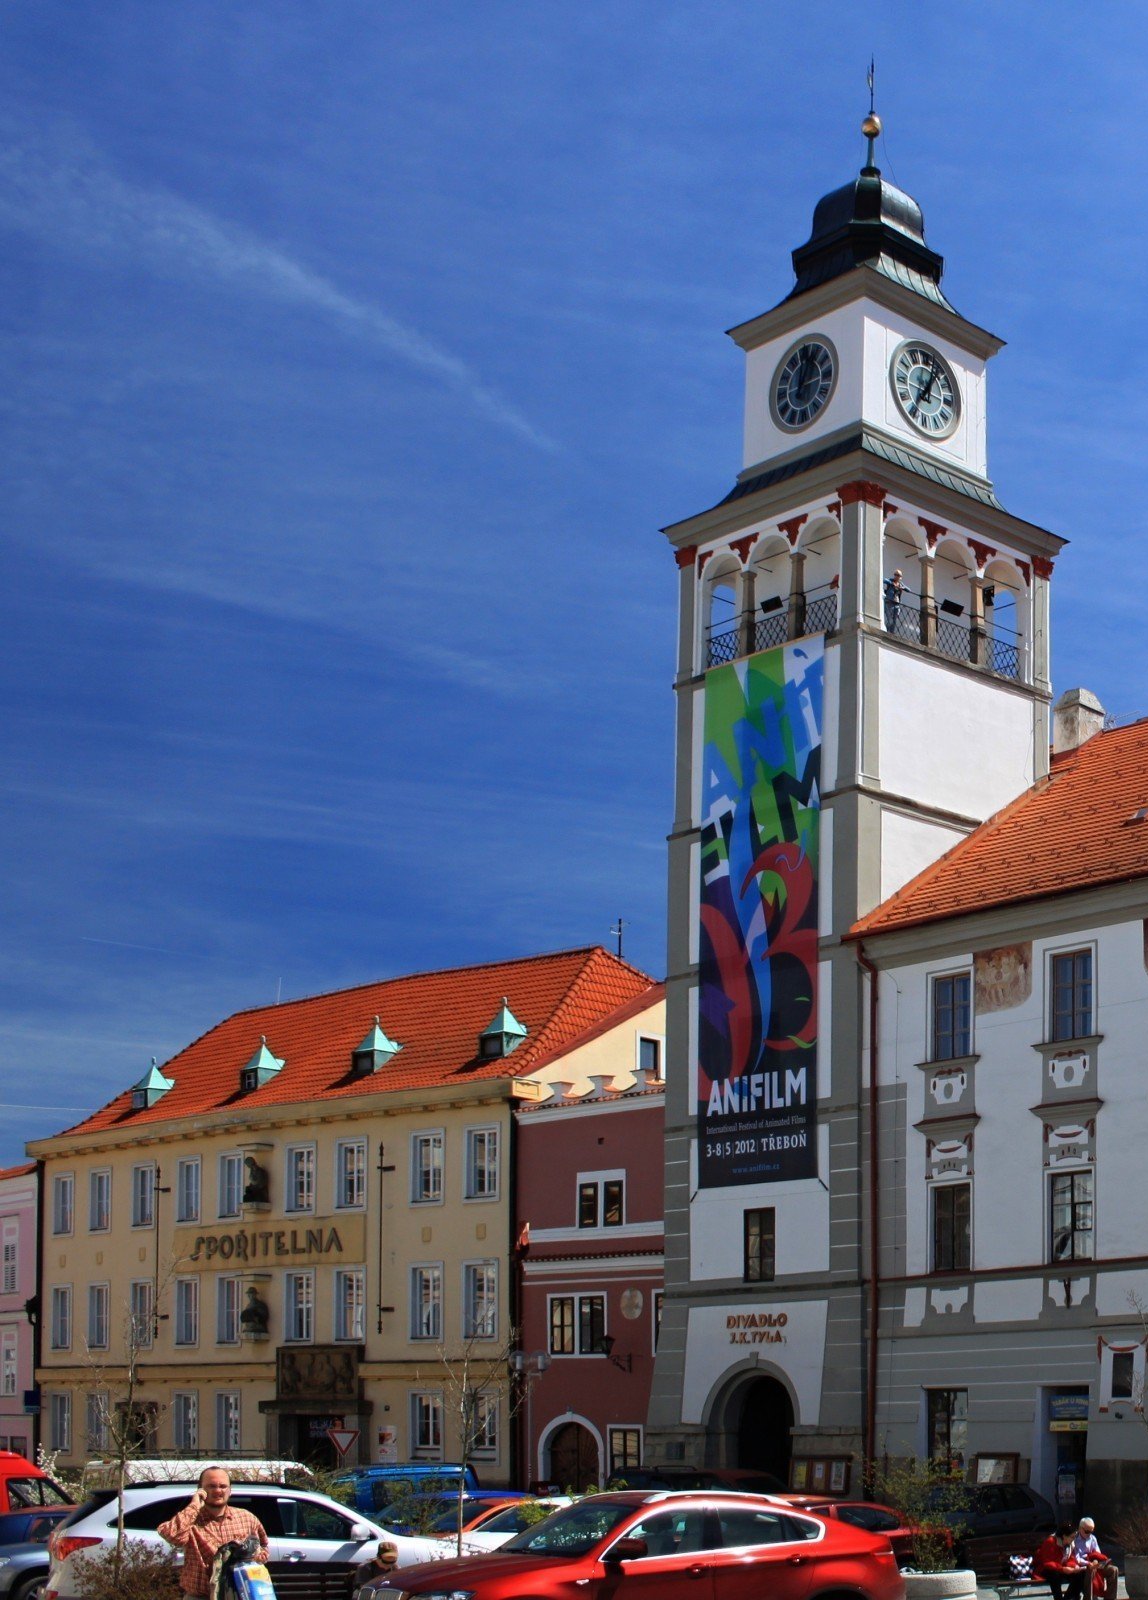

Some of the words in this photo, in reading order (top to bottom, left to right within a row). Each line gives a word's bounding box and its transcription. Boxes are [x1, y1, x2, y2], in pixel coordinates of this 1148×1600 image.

[706, 1066, 807, 1117] ANIFILM
[706, 1122, 738, 1135] International
[738, 1119, 758, 1131] Festival
[758, 1119, 765, 1128] of
[765, 1116, 791, 1128] Animated
[791, 1115, 806, 1124] Films
[761, 1129, 807, 1151] TŘEBOŇ
[732, 1163, 780, 1174] www.anifilm.cz
[189, 1227, 343, 1261] SPOŘITELNA
[726, 1312, 788, 1329] DIVADLO
